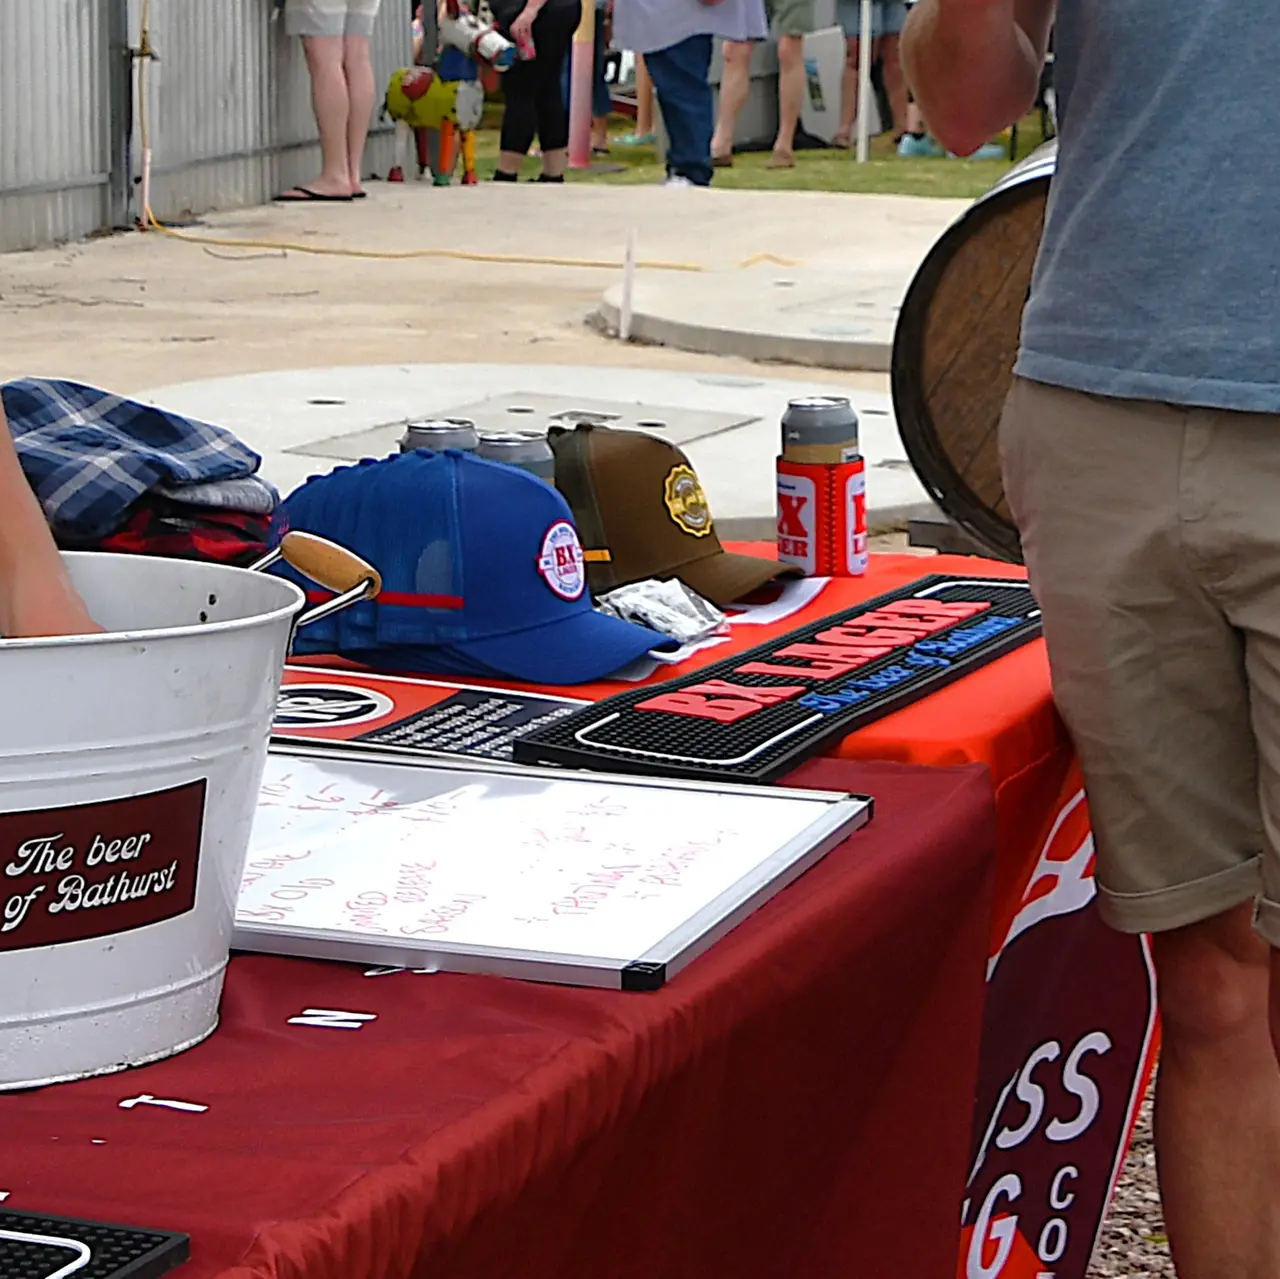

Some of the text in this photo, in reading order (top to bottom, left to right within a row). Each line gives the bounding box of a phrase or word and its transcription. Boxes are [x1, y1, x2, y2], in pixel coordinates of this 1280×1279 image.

[554, 544, 577, 567] BX
[634, 598, 991, 725] BX LAGER
[798, 688, 870, 714] The
[847, 665, 916, 691] beer
[4, 830, 152, 878] The beer
[0, 885, 46, 933] of
[47, 860, 181, 915] Bathurst
